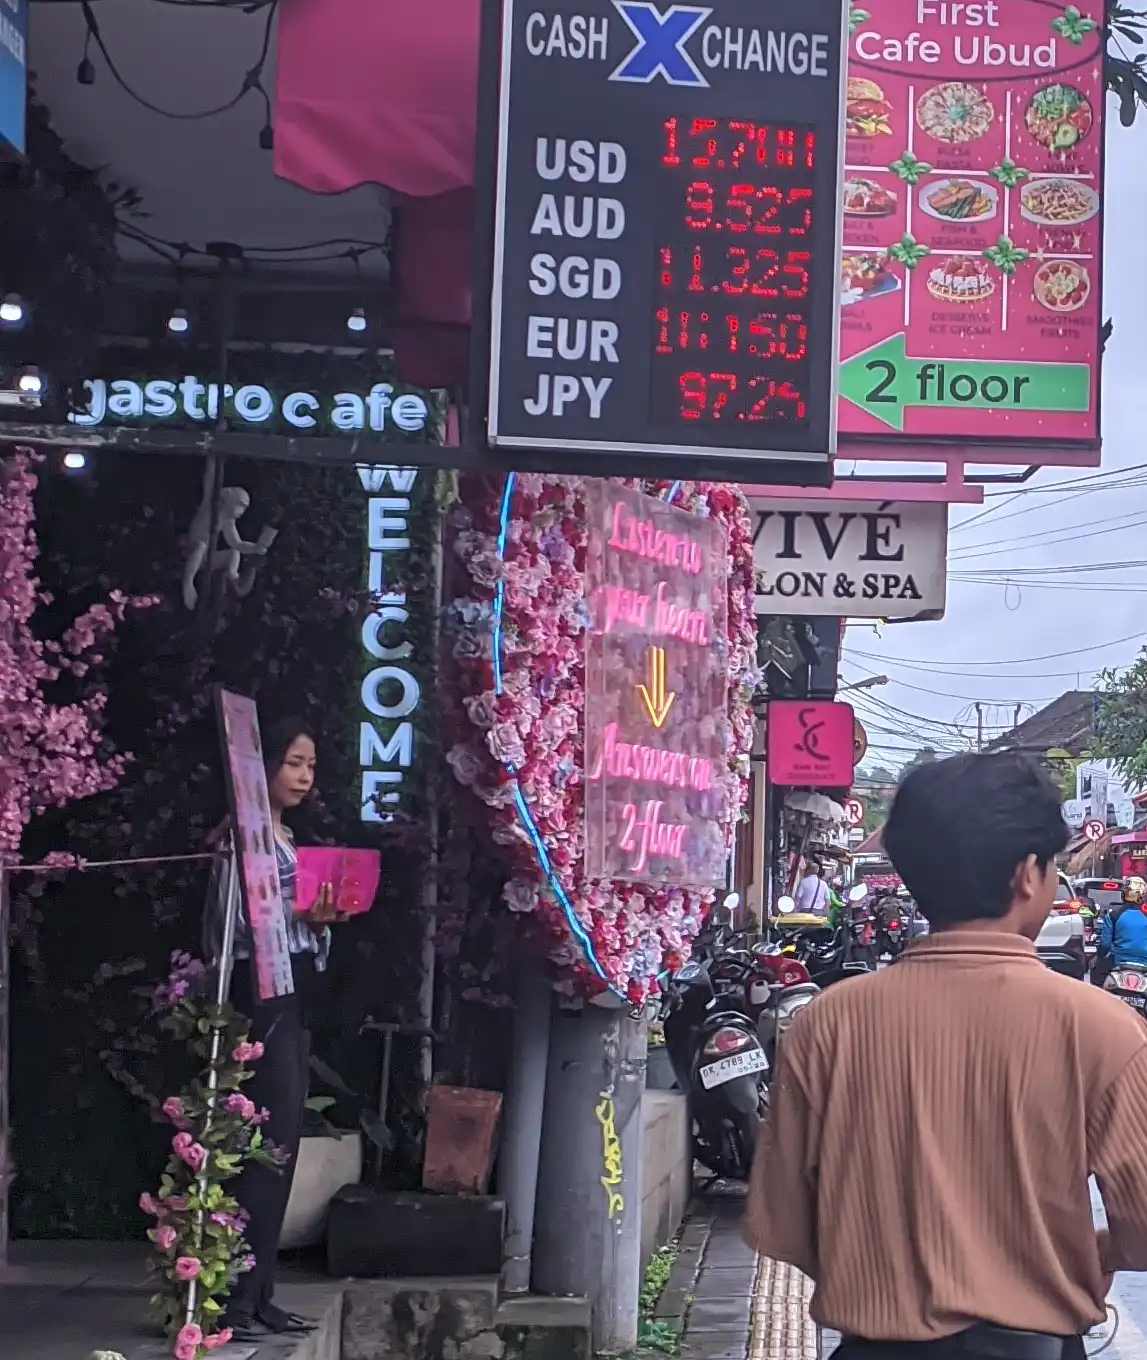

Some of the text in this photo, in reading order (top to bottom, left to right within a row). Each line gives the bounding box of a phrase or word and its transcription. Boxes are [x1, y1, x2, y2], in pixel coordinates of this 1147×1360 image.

[525, 11, 609, 61] CASH
[855, 31, 1056, 68] Cafe Ubud
[536, 137, 627, 184] USD
[529, 192, 626, 239] AUD
[528, 253, 622, 300] SGD
[526, 315, 620, 364] EUR
[68, 376, 273, 426] gastro
[523, 373, 613, 419] JPY
[865, 359, 1030, 404] 2 floor
[832, 572, 856, 599] &
[862, 572, 923, 600] SPA
[356, 463, 420, 822] WELCOME
[619, 803, 636, 851] 2
